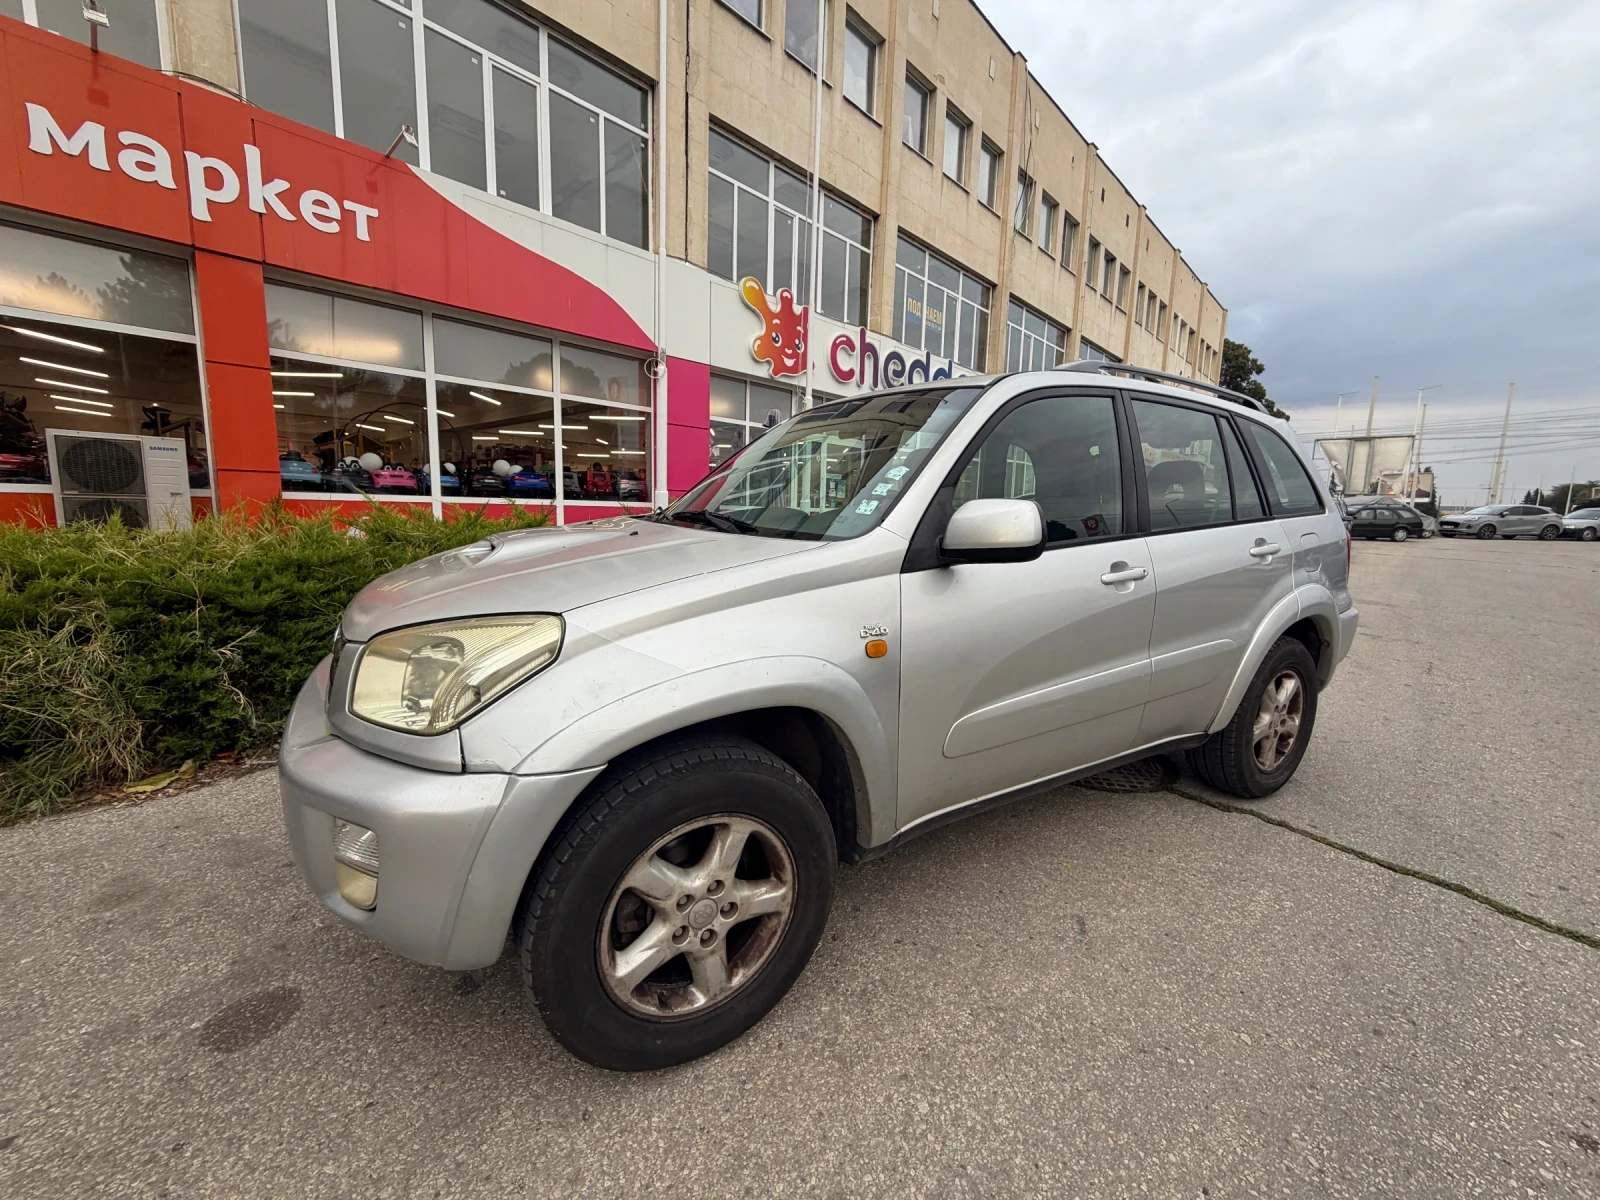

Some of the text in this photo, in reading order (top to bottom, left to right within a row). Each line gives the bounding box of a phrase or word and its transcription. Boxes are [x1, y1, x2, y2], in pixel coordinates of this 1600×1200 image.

[25, 102, 378, 242] маркет
[907, 297, 921, 318] ПОД
[830, 327, 968, 389] chedd
